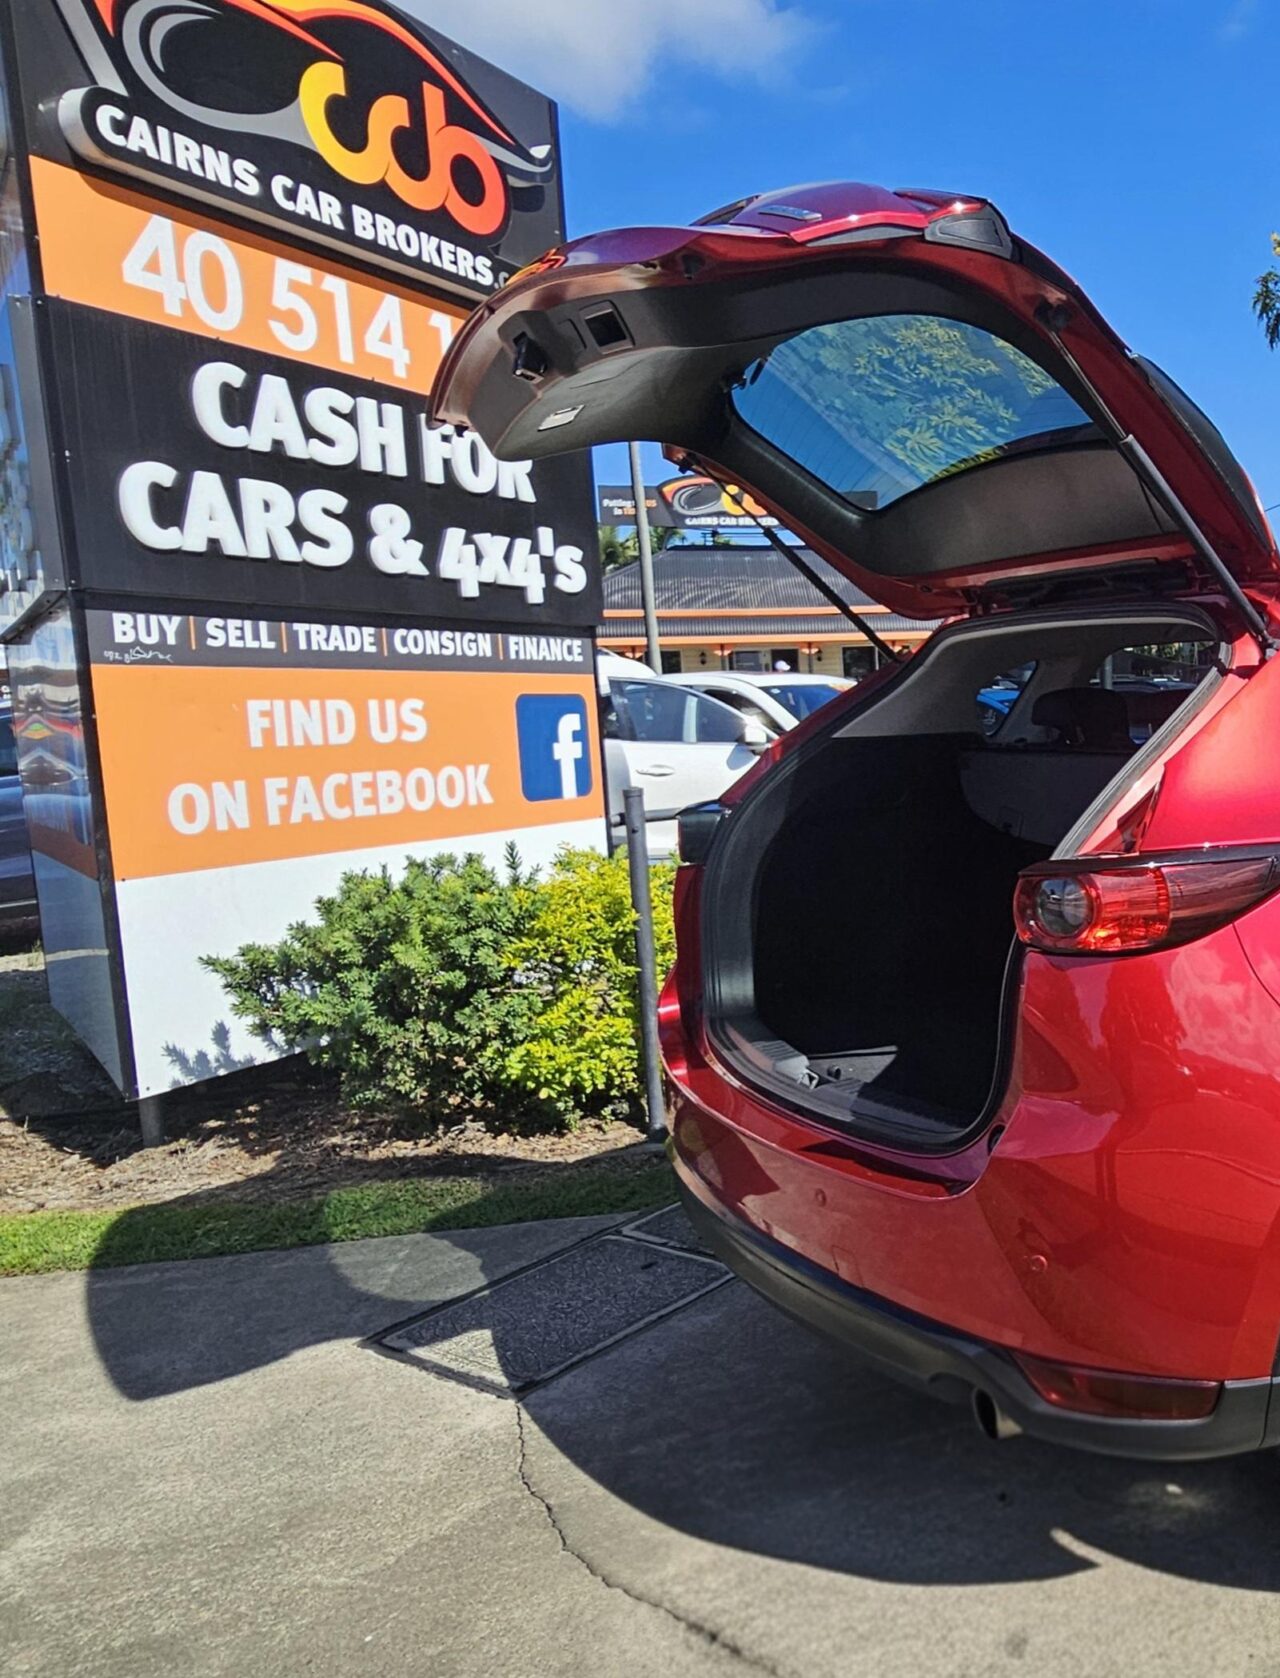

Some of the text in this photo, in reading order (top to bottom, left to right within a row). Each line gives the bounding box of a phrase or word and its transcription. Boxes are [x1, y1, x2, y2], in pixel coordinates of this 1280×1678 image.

[95, 104, 261, 196] CAIRNS
[271, 174, 345, 230] CAR
[121, 214, 245, 331] 40
[268, 257, 411, 379] 514
[192, 361, 408, 477] CASH
[118, 460, 354, 567] CARS
[369, 503, 430, 576] &
[112, 612, 584, 663] BUY SELL TRADE CONSIGN FINANCE
[246, 697, 429, 748] FIND US
[167, 763, 495, 836] ON FACEBOOK
